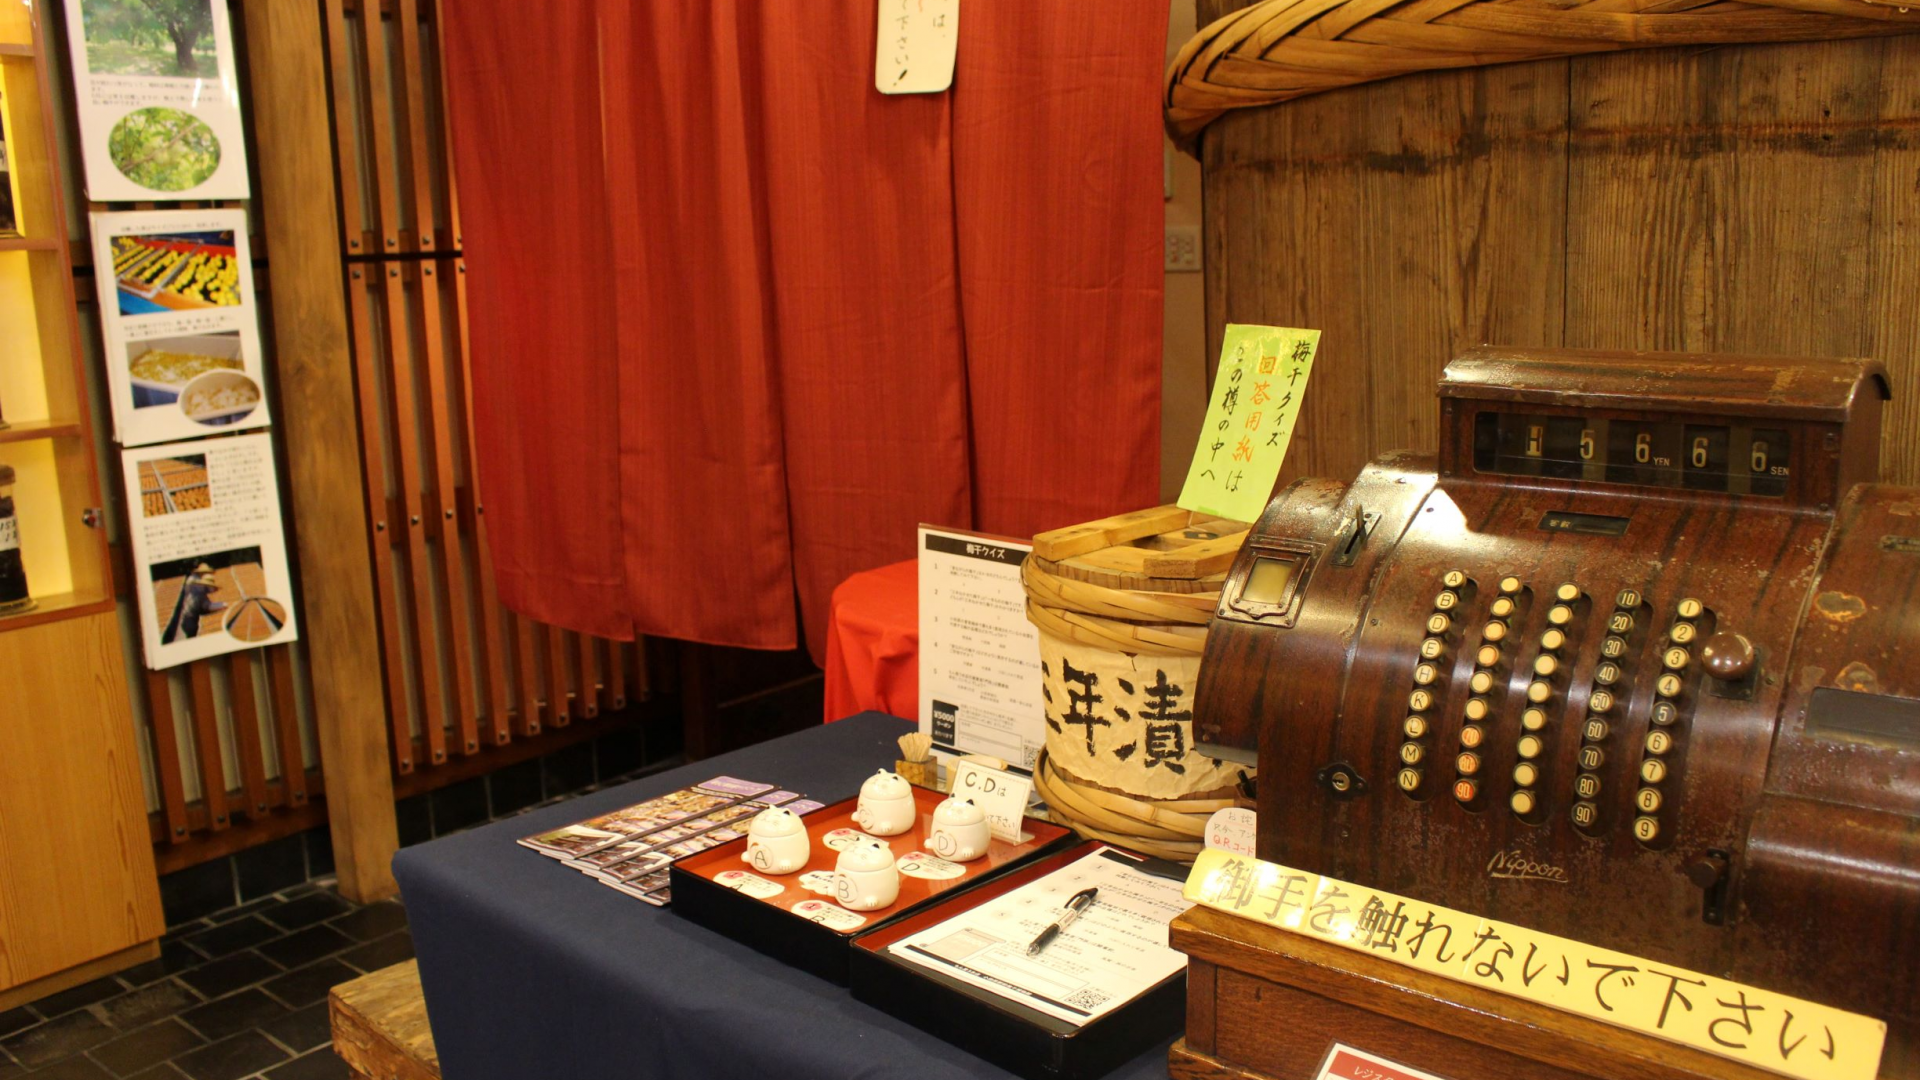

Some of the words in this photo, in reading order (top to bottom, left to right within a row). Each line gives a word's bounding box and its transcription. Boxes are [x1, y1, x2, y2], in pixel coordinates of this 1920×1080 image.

[1266, 340, 1312, 447] 梅干クイズ
[1226, 355, 1277, 492] 回答用紙は
[1580, 429, 1595, 459] 5
[1635, 433, 1650, 463] 6
[1692, 437, 1709, 468] 6
[1751, 441, 1769, 472] 6
[1770, 466, 1790, 476] SEN
[966, 543, 1005, 559] 梅干クイズ
[1621, 592, 1635, 606] 10
[1432, 617, 1444, 629] D
[1613, 616, 1627, 630] 20
[1425, 642, 1437, 656] E
[1605, 640, 1620, 655] 30
[1418, 667, 1431, 681] H
[1599, 665, 1614, 681] 40
[1413, 694, 1424, 708] K
[1593, 694, 1608, 708] 50
[1587, 722, 1602, 738] 60
[1405, 747, 1416, 760] M
[1584, 750, 1598, 766] 70
[1403, 773, 1413, 787] N
[1579, 778, 1593, 795] 80
[1457, 782, 1470, 798] 90
[986, 814, 1015, 828] て下さい
[1575, 806, 1590, 823] 90
[1213, 834, 1255, 856] QRコード
[754, 850, 768, 866] A
[1487, 850, 1567, 881] Nippon
[837, 880, 849, 900] B
[1210, 857, 1834, 1060] 御手を触れないで下さい
